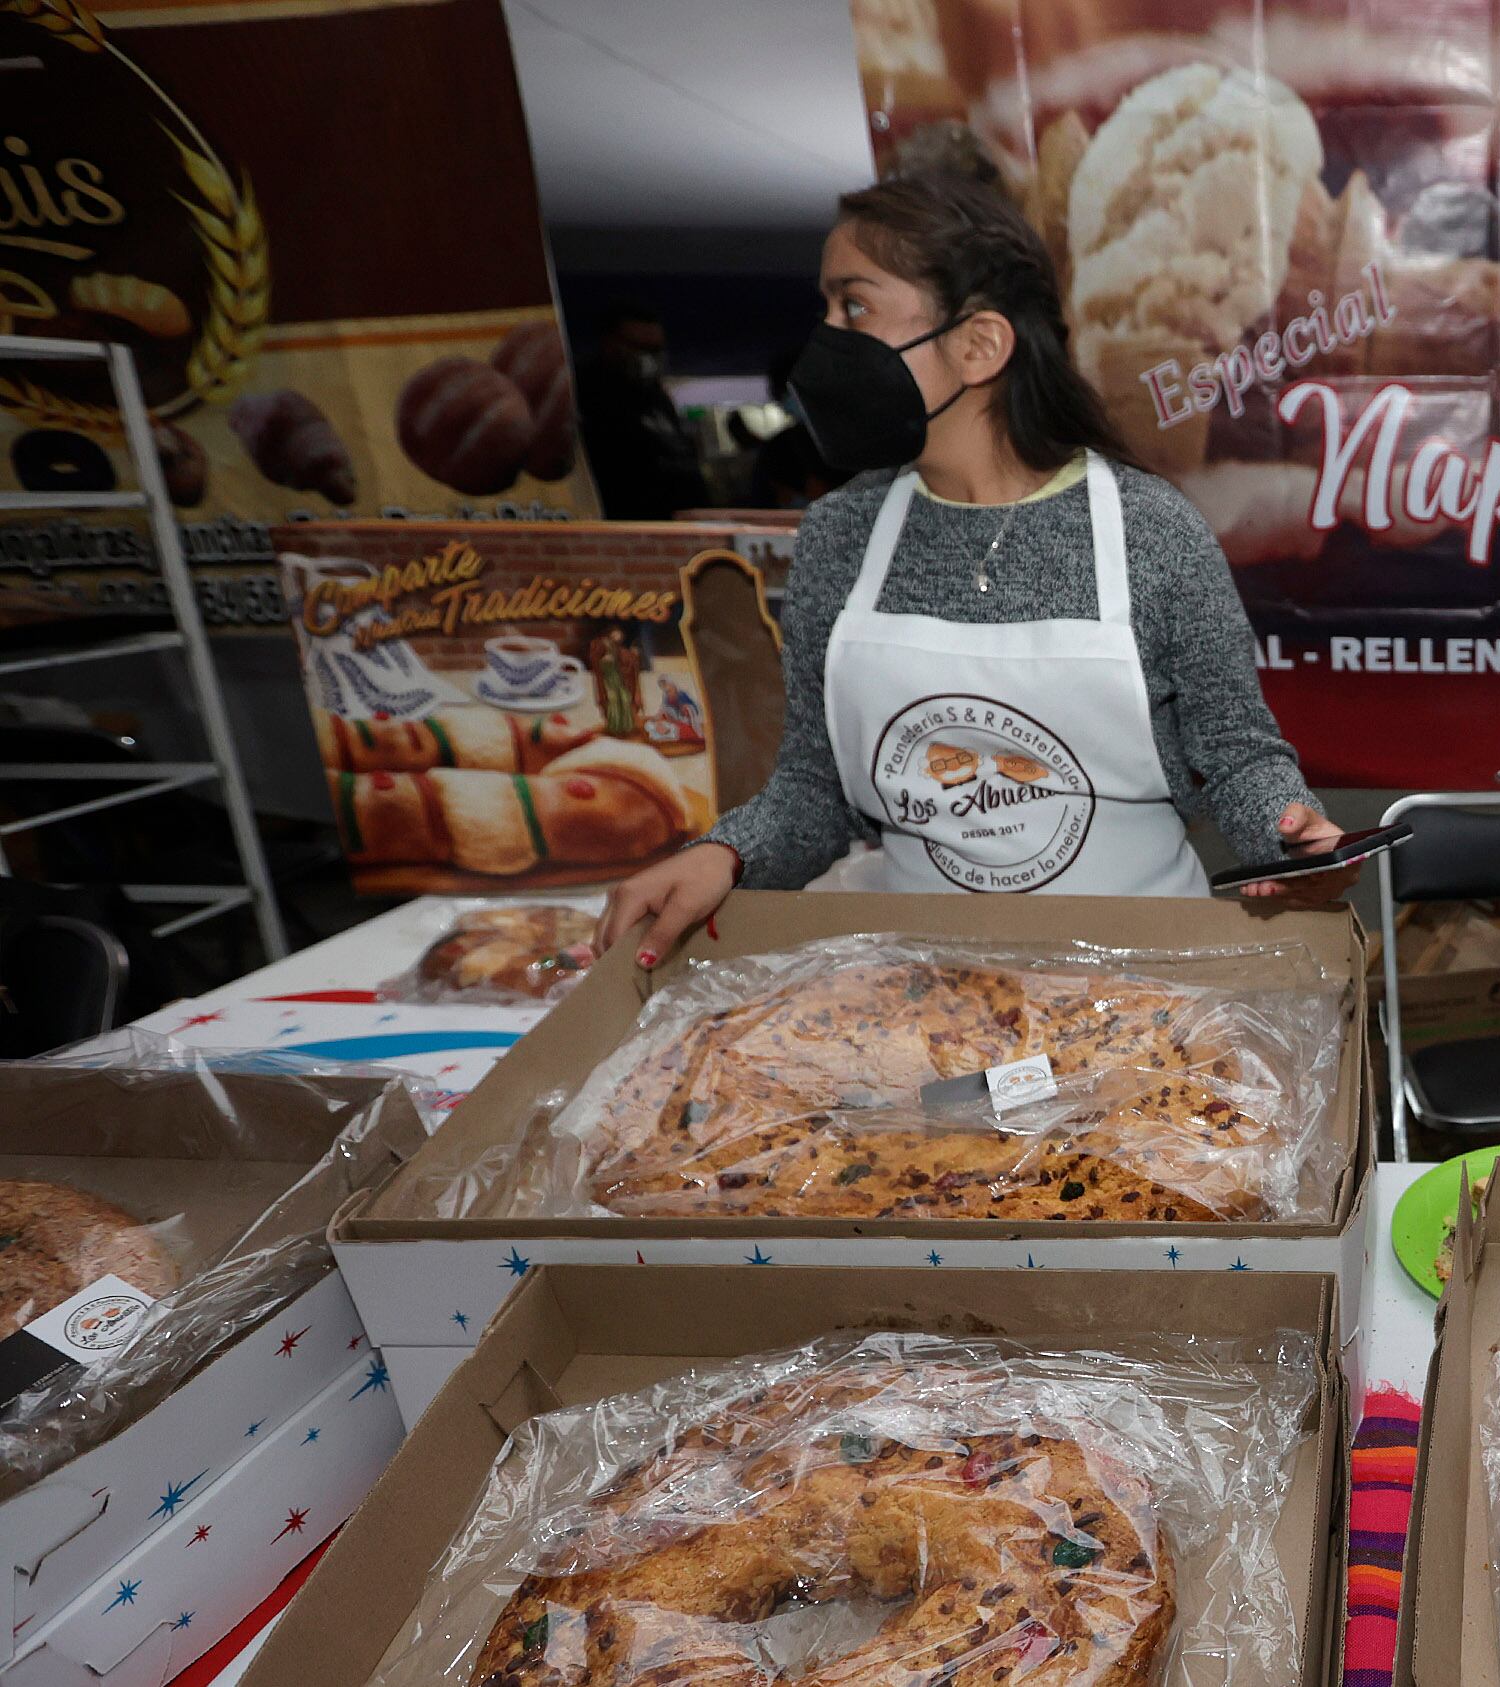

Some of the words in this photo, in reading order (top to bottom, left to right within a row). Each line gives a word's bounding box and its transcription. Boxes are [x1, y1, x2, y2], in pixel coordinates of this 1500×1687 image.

[1139, 262, 1398, 431] Especial
[303, 539, 487, 636] Comparte
[431, 573, 679, 637] Tradiciones
[946, 705, 957, 722] S
[963, 707, 976, 723] &
[984, 711, 995, 727] R
[893, 788, 938, 825] Los
[961, 828, 997, 840] DESDE
[999, 822, 1026, 836] 2017
[964, 867, 984, 885] de
[990, 867, 1037, 887] hacer
[1037, 859, 1056, 873] lo
